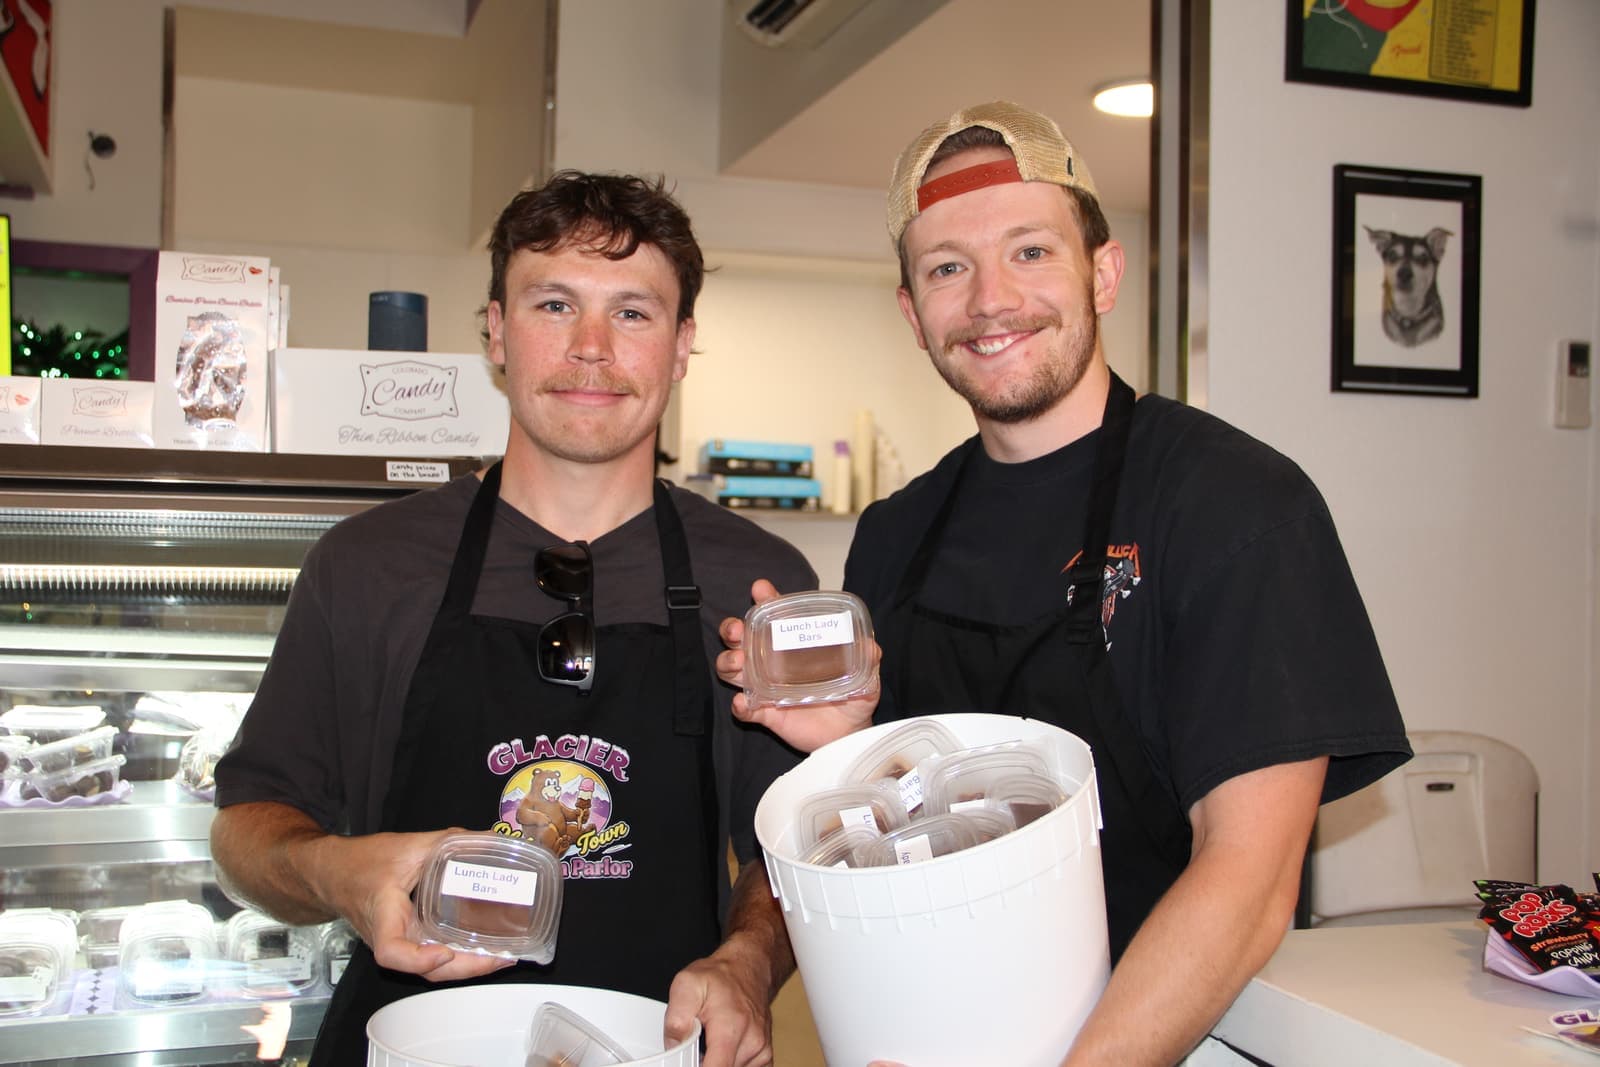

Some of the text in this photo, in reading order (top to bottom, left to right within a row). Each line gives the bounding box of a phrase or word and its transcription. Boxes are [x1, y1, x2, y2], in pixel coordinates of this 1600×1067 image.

[372, 377, 446, 406] Candy
[338, 425, 480, 447] Thin Ribbon Candy
[780, 618, 839, 633] Lunch Lady
[798, 633, 822, 642] Bars
[487, 733, 631, 783] GLACIER
[576, 820, 631, 856] Town
[454, 866, 519, 885] Lunch Lady
[571, 856, 633, 880] Parlor
[472, 882, 497, 894] Bars
[1499, 892, 1544, 923] POP
[1513, 899, 1576, 938] ROCKS
[1550, 942, 1593, 960] POPPING
[1568, 952, 1600, 967] CANDY
